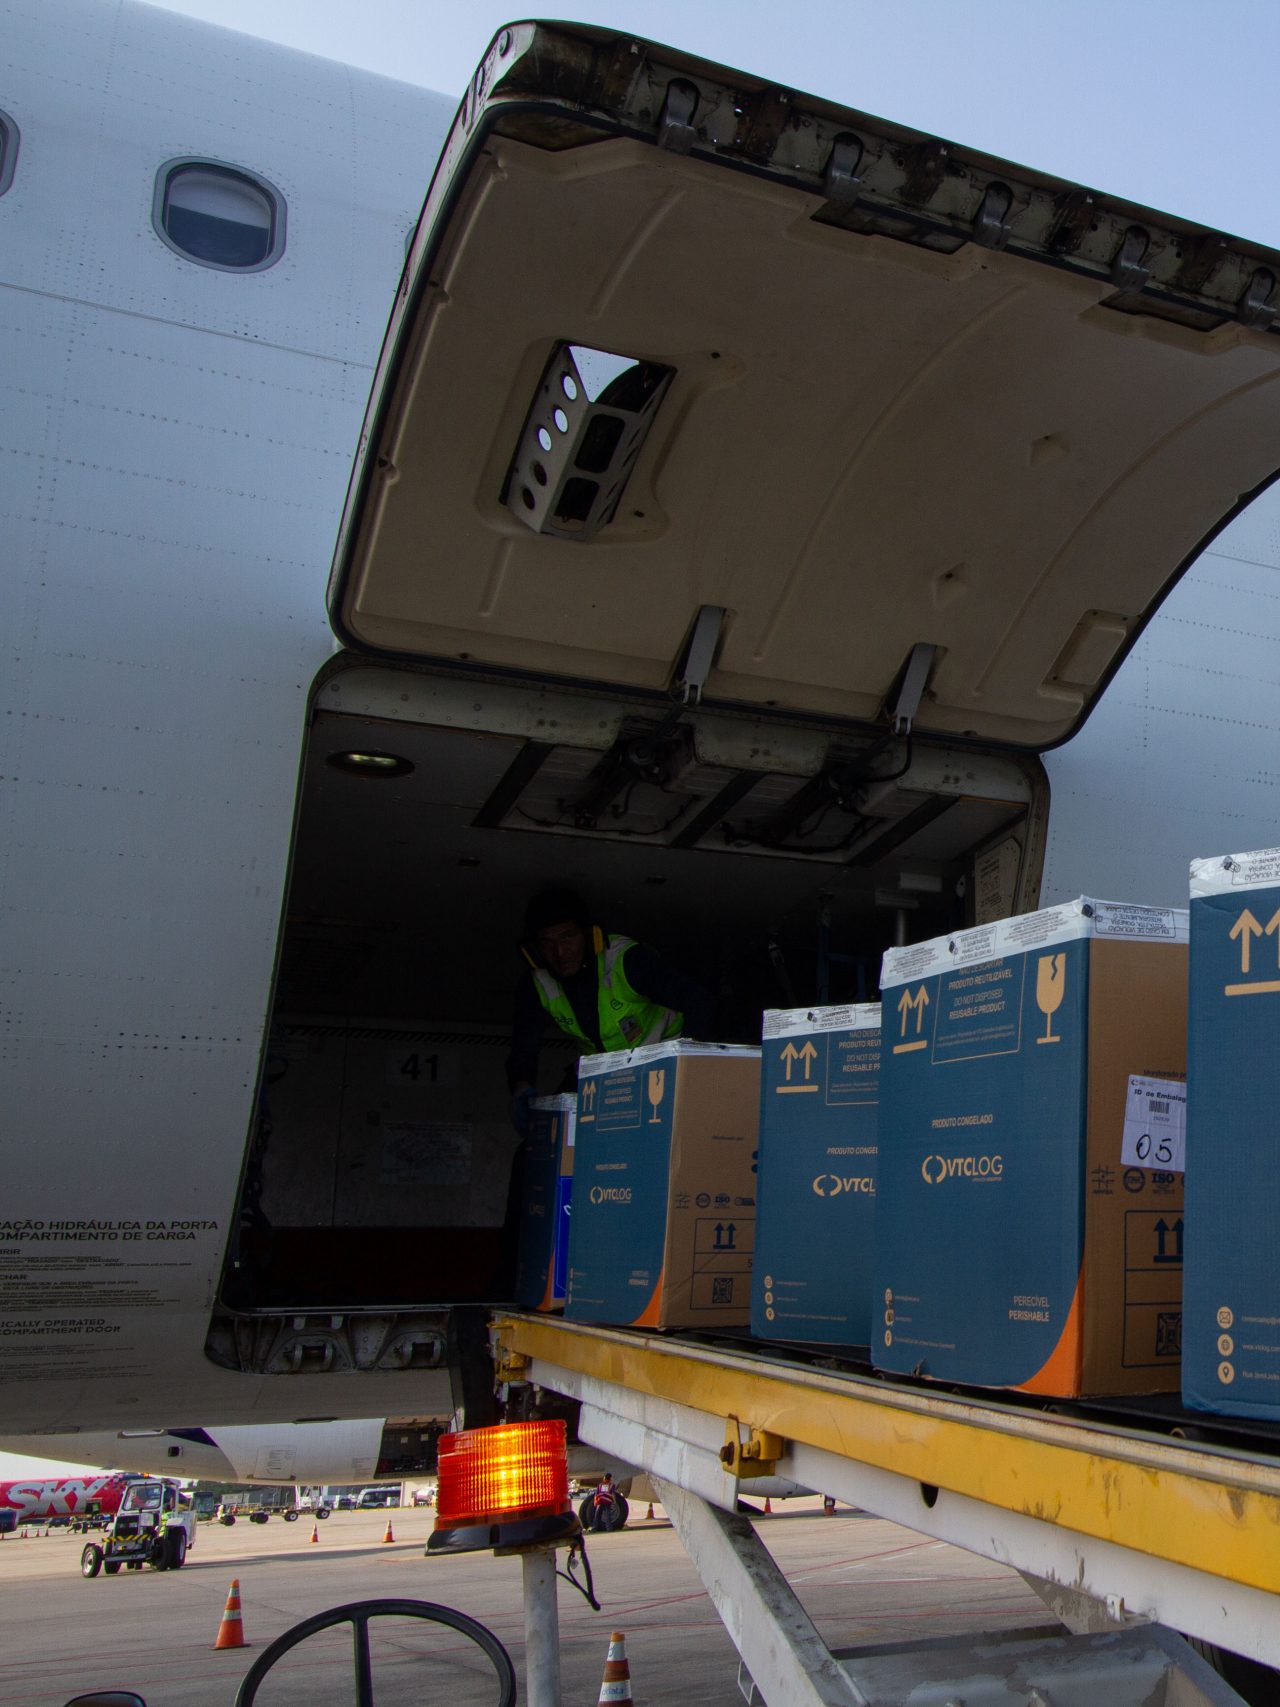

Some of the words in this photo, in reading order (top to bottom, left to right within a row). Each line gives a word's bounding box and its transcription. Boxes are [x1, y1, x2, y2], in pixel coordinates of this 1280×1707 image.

[400, 1053, 439, 1081] 41
[1134, 1088, 1143, 1096] ID
[957, 1113, 993, 1126] CONGELADO
[1135, 1133, 1173, 1164] 05
[947, 1155, 1003, 1176] VTCLOG
[1152, 1173, 1175, 1183] ISO
[842, 1178, 876, 1193] VTCL
[603, 1188, 632, 1201] VTCLOG
[49, 1219, 141, 1231] HIDRÁULICA
[145, 1221, 166, 1230] DA
[170, 1220, 219, 1230] PORTA
[122, 1231, 142, 1241] DE
[146, 1231, 197, 1240] CARGA
[1008, 1309, 1050, 1322] PERISHABLE
[44, 1318, 106, 1327] OPERATED
[85, 1326, 121, 1334] DOOR
[8, 1479, 111, 1515] SKY
